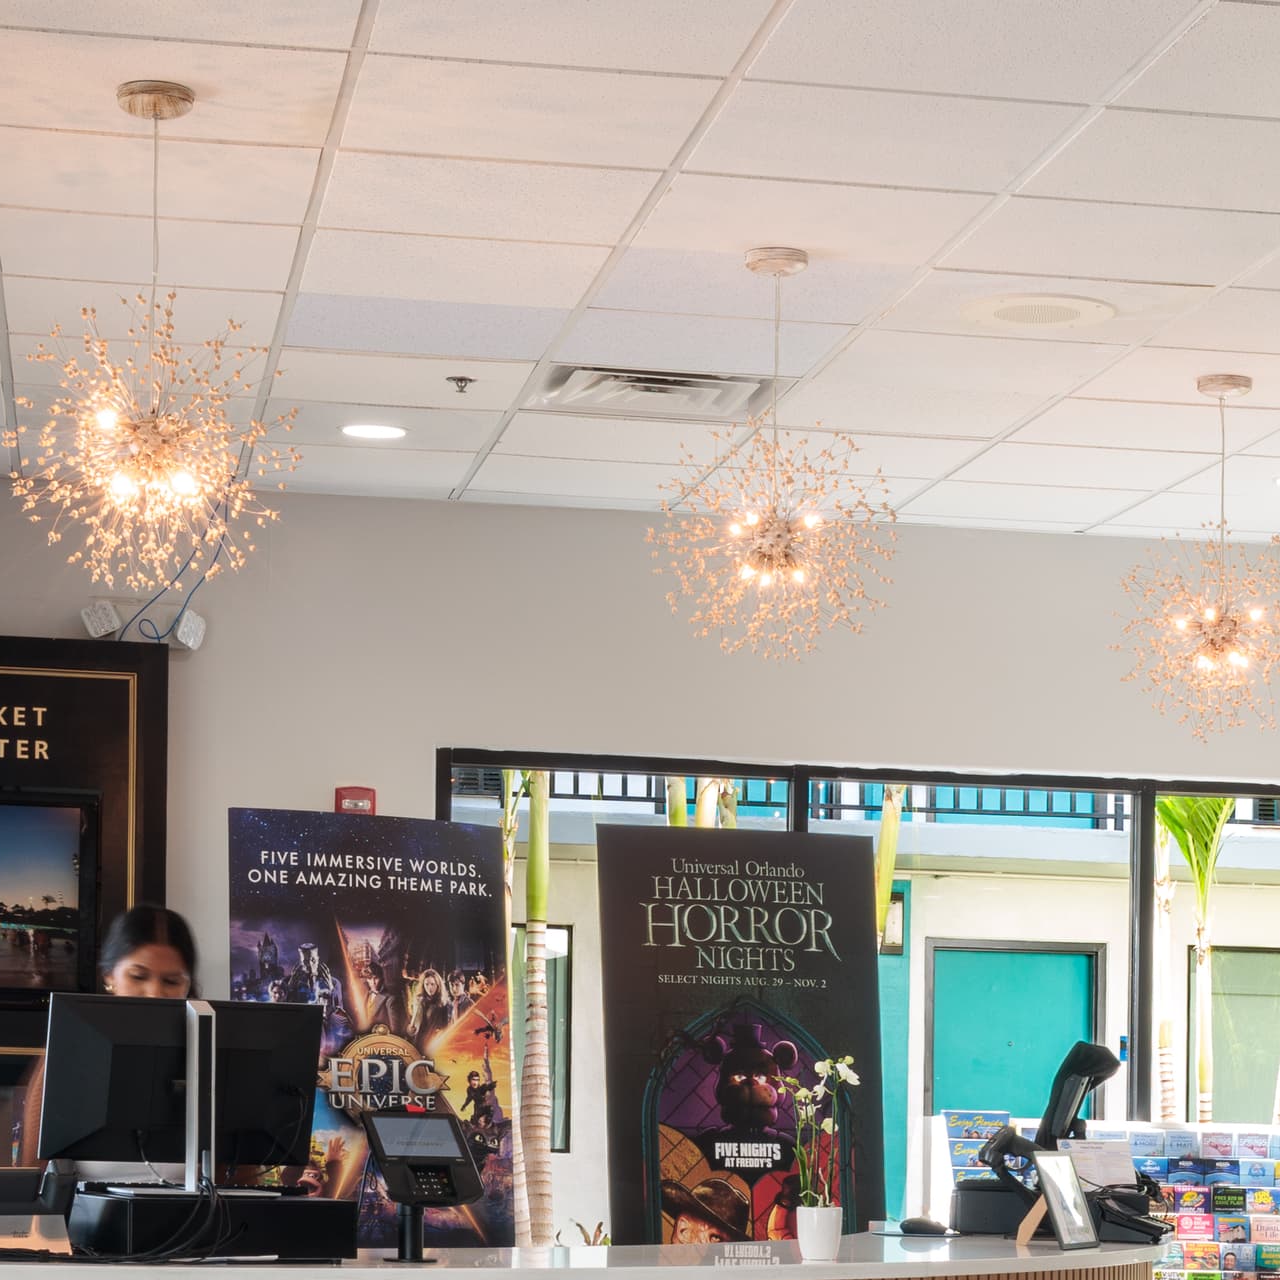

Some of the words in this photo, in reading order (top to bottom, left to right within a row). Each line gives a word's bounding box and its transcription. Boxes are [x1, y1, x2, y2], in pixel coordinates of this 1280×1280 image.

[260, 850, 299, 867] FIVE
[307, 852, 403, 872] IMMERSIVE
[409, 859, 481, 879] WORLDS.
[671, 858, 739, 876] Universal
[745, 860, 805, 878] Orlando
[248, 869, 288, 884] ONE
[295, 871, 382, 889] AMAZING
[387, 876, 443, 893] THEME
[450, 881, 492, 897] PARK.
[652, 876, 824, 905] HALLOWEEN
[639, 903, 842, 962] HORROR
[695, 945, 795, 972] NIGHTS
[658, 974, 698, 984] SELECT
[701, 975, 741, 985] NIGHTS
[744, 976, 769, 986] AUG.
[772, 977, 784, 986] 29
[794, 979, 819, 988] NOV.
[821, 979, 827, 988] 2
[357, 1047, 410, 1056] UNIVERSAL
[328, 1058, 437, 1095] EPIC
[714, 1142, 738, 1160] FIVE
[740, 1143, 781, 1161] NIGHTS
[725, 1158, 735, 1168] AT
[736, 1158, 773, 1168] FREDDY'S
